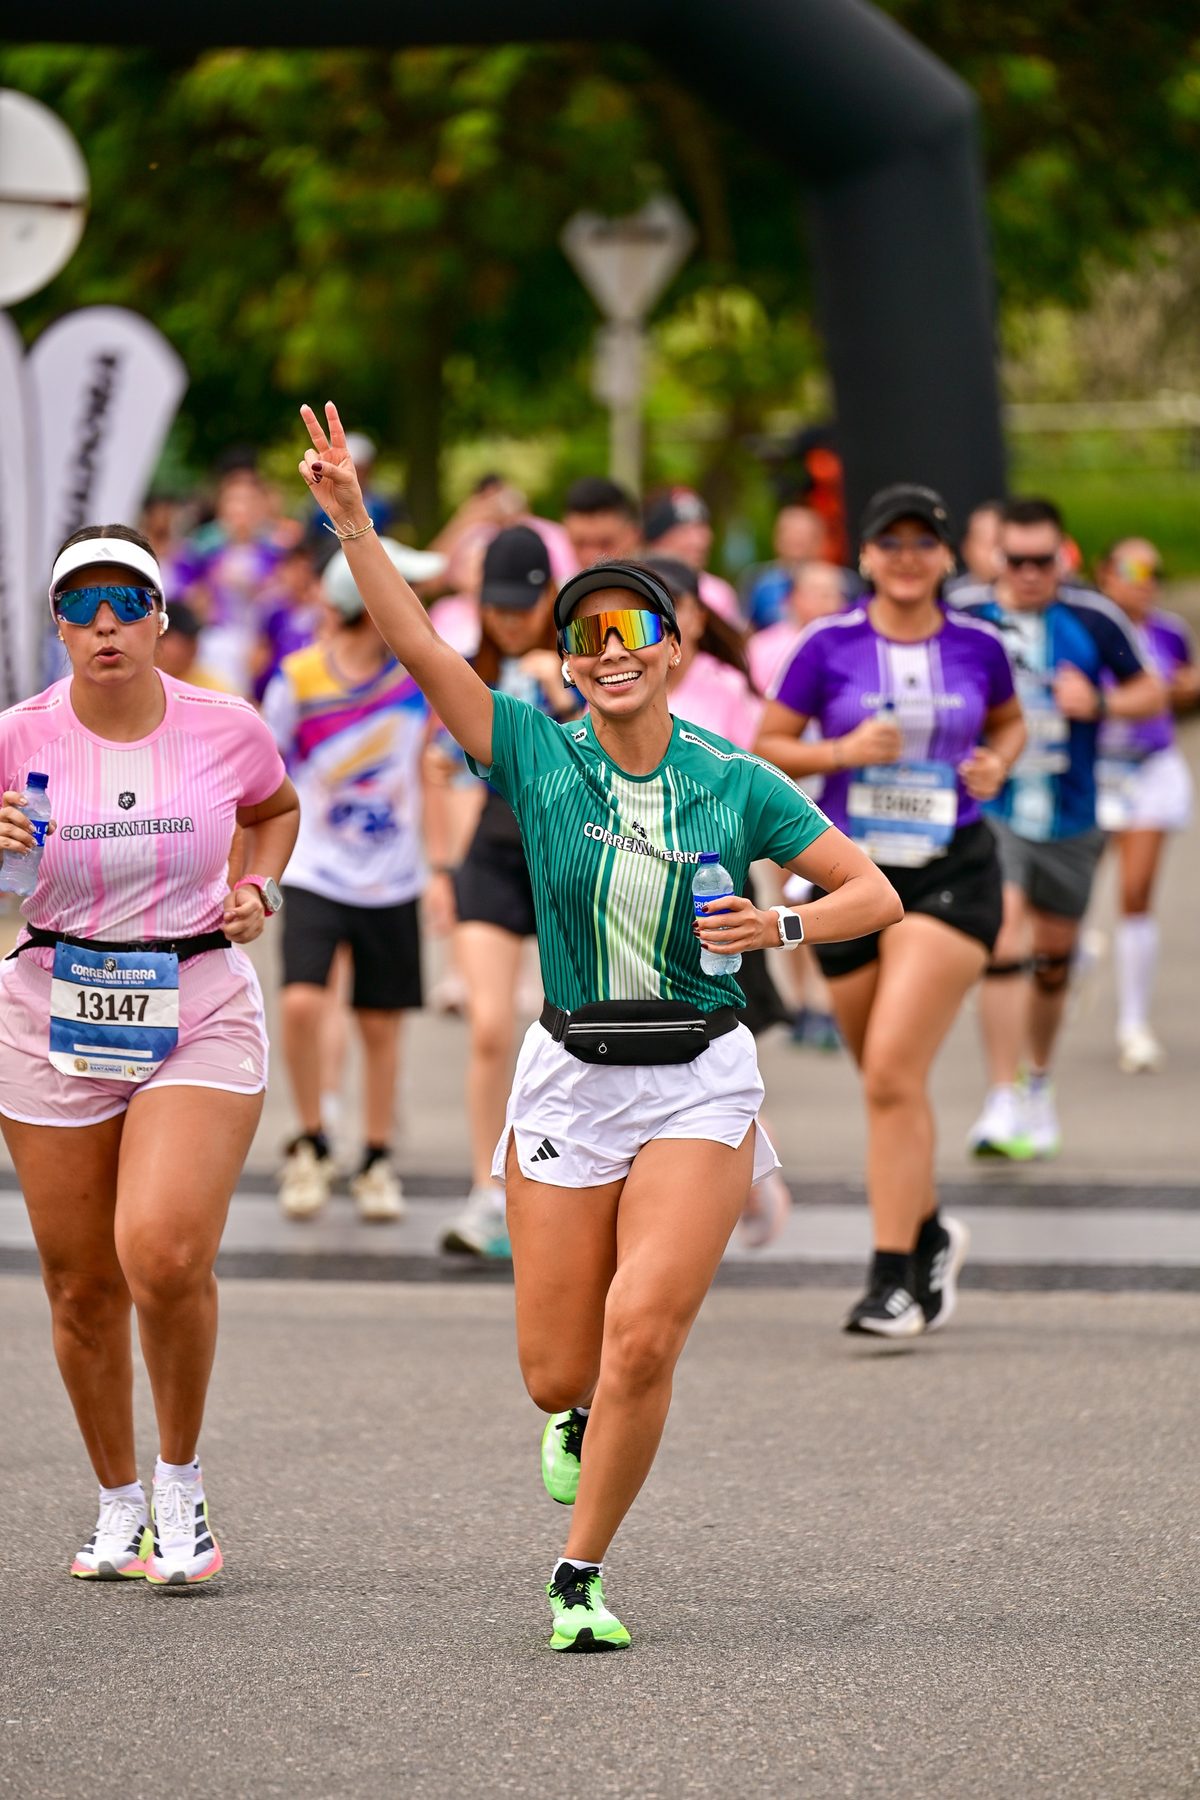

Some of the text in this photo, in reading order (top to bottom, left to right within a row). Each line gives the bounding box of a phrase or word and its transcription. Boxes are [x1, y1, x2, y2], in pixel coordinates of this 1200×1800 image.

[60, 817, 194, 841] CORREMITIERRA
[71, 963, 156, 980] CORREMITIERRA
[76, 990, 150, 1022] 13147
